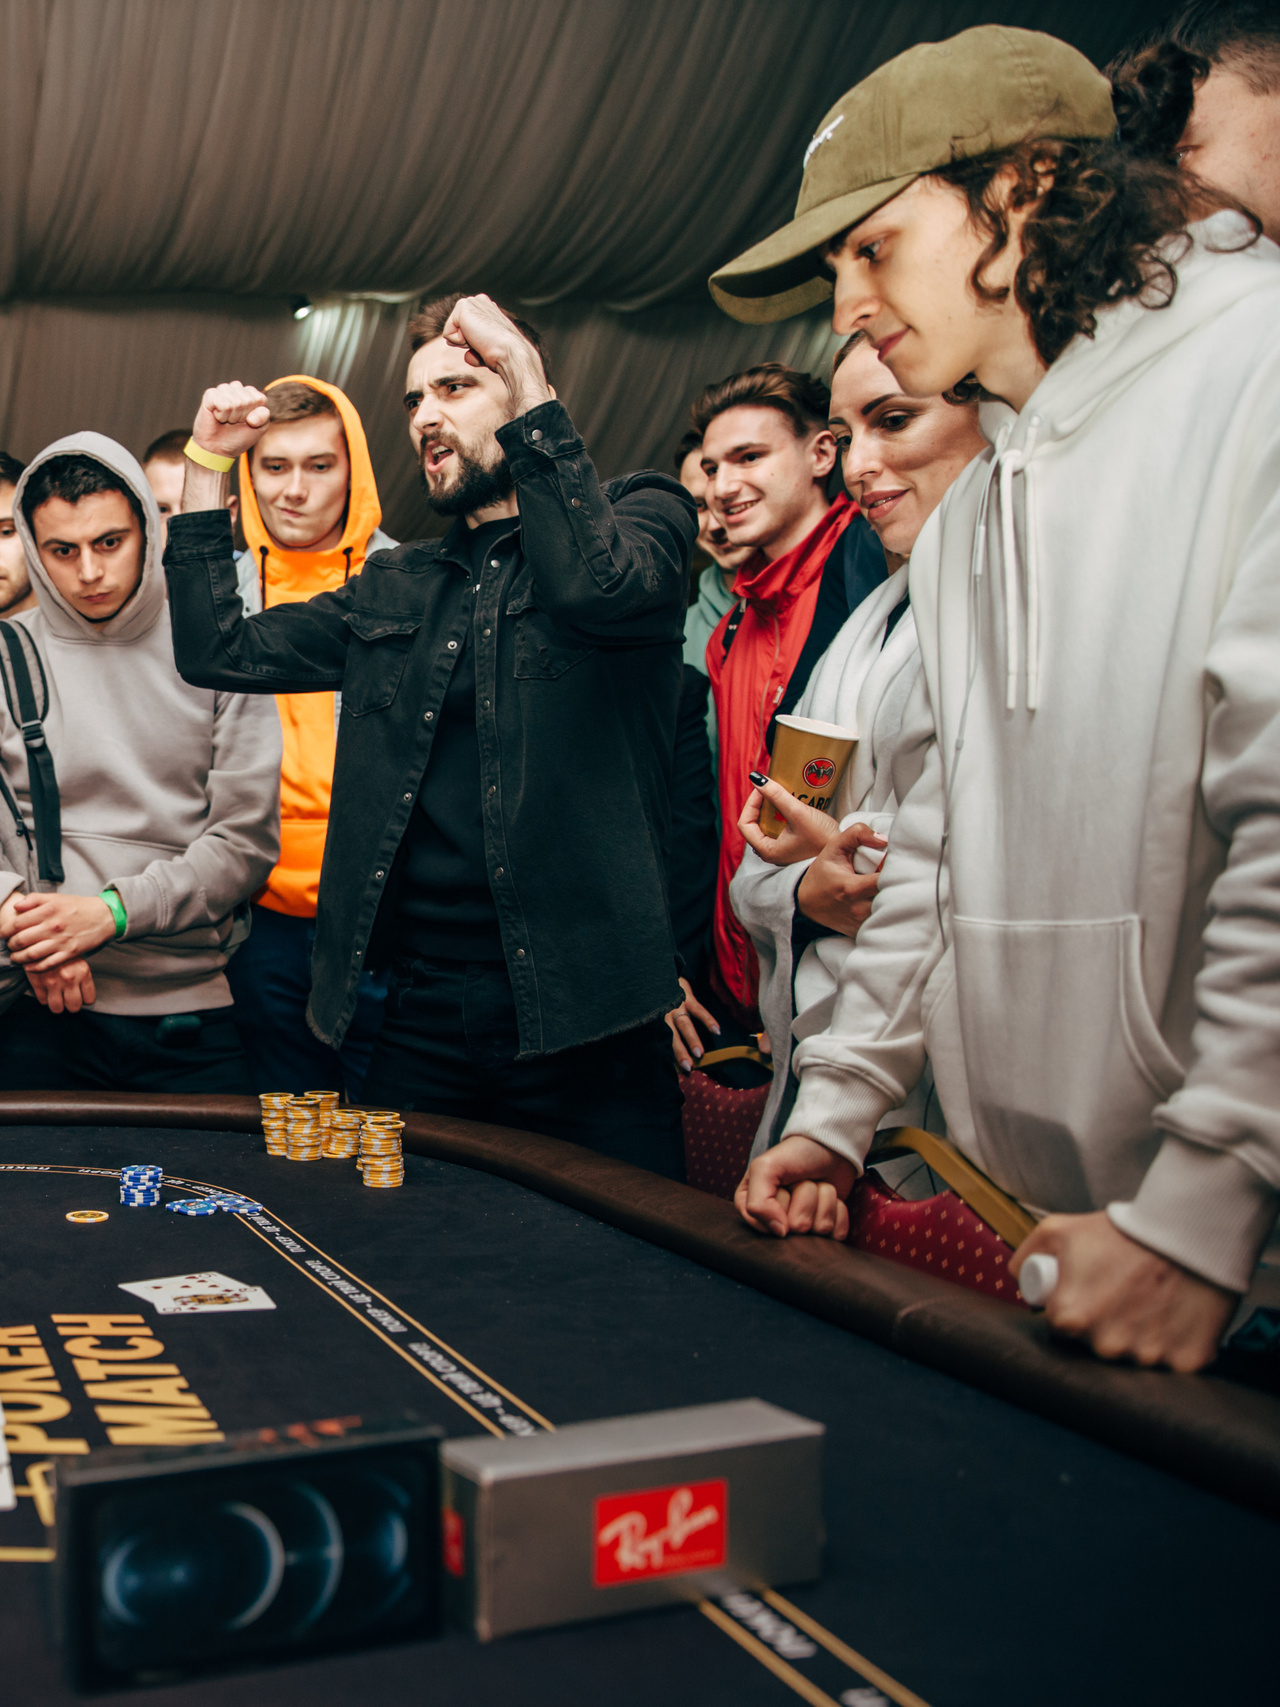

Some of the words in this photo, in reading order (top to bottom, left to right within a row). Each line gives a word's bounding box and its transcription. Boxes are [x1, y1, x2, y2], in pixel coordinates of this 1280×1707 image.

[191, 1185, 223, 1196] ОКЕР
[366, 1308, 408, 1333] ПОКЕР
[50, 1313, 226, 1446] MATCH
